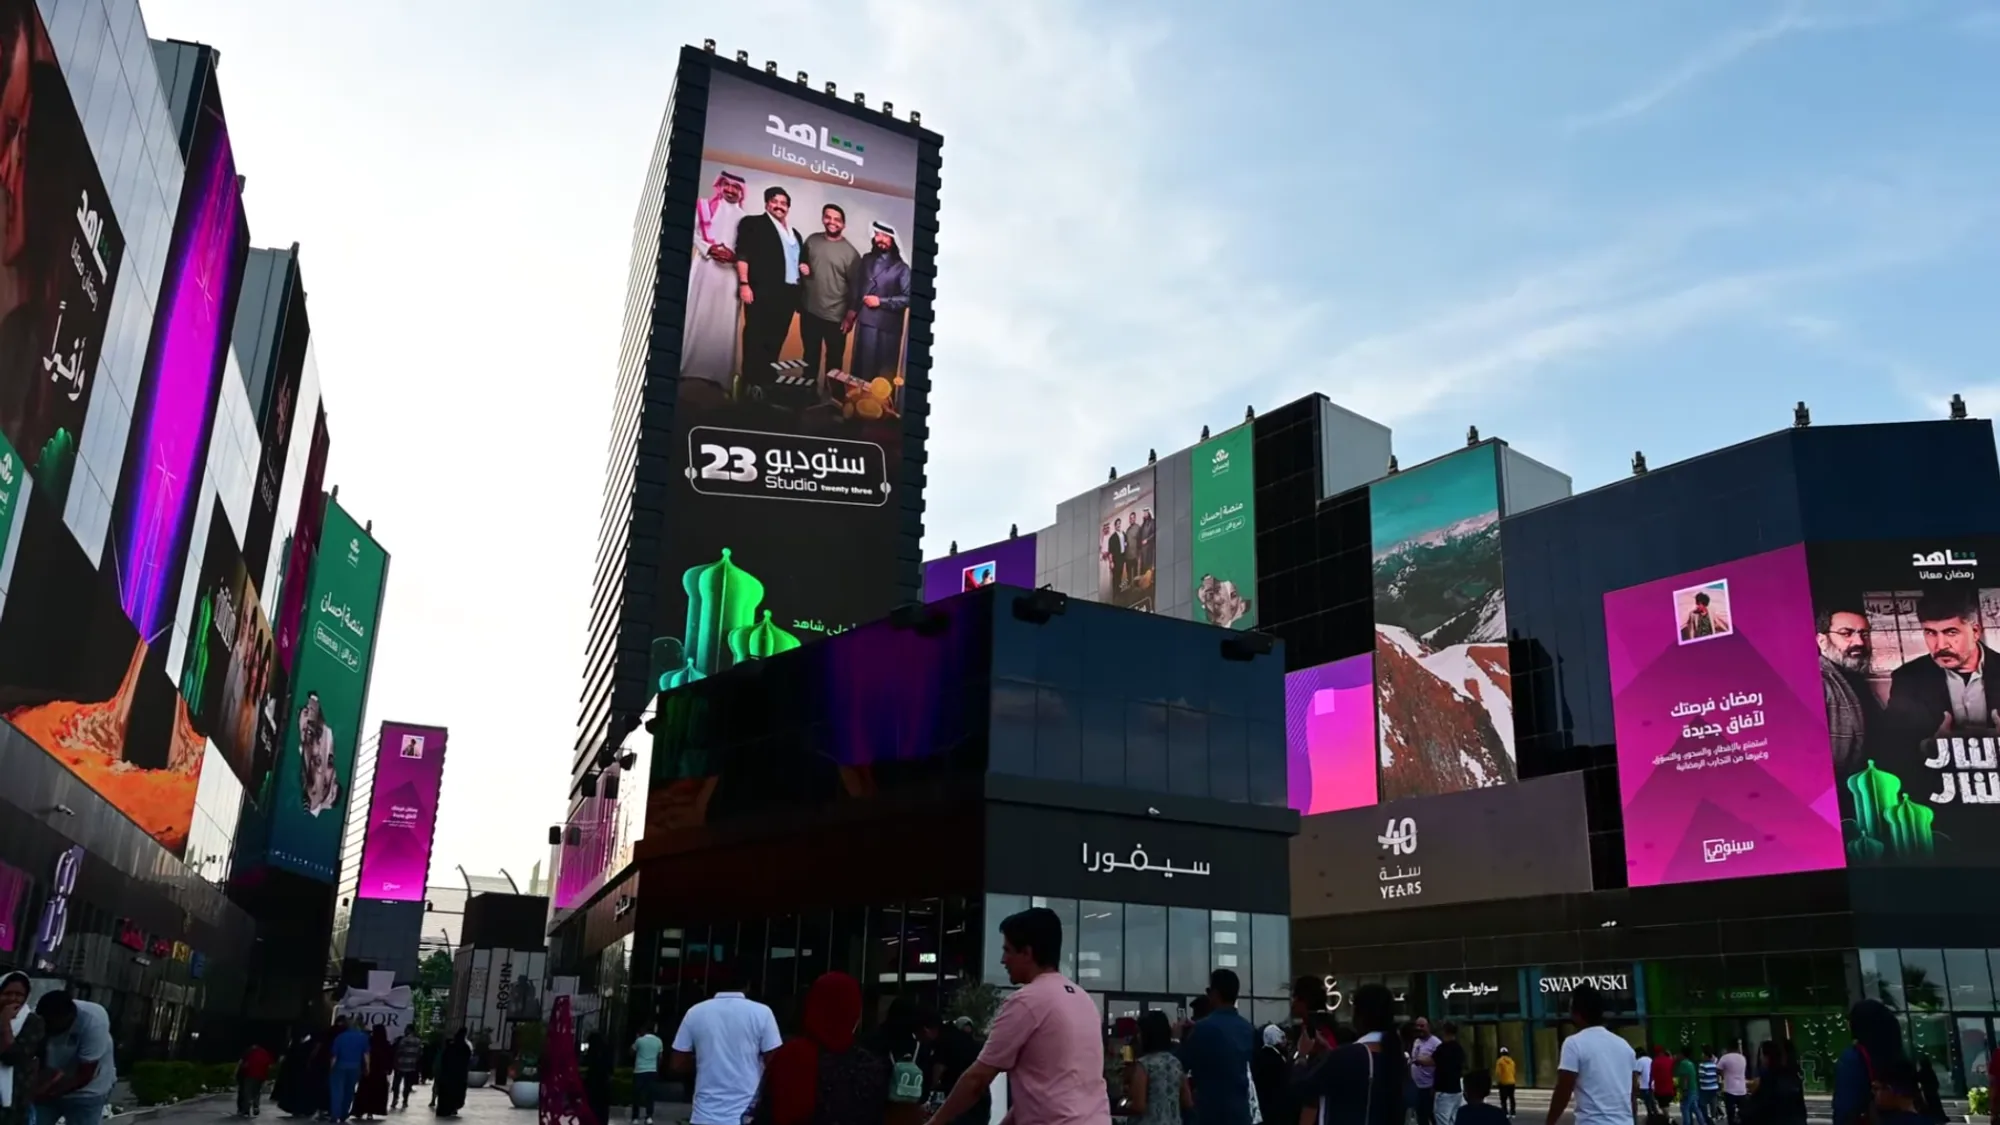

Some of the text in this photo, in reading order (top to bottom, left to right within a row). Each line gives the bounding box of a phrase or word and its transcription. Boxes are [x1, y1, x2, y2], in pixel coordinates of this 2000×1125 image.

[766, 114, 864, 166] شاهد
[771, 144, 855, 184] رمضان معانا
[700, 444, 866, 482] ستوديو 23
[765, 476, 873, 495] Studio twenty three
[1912, 549, 1978, 566] شاهد
[1919, 570, 1974, 581] رمضان معانا
[793, 619, 825, 632] شاهد
[1670, 691, 1763, 717] رمضان فرصتك
[1682, 711, 1764, 739] لآفاق جديدة
[1378, 817, 1418, 855] 40
[1083, 842, 1210, 878] سيفورا
[1379, 865, 1421, 881] سنة
[1380, 881, 1422, 899] YEARS
[496, 963, 512, 1010] ROSHN
[1442, 981, 1498, 999] سواروفسكي
[1539, 974, 1628, 993] SWAROVSKI
